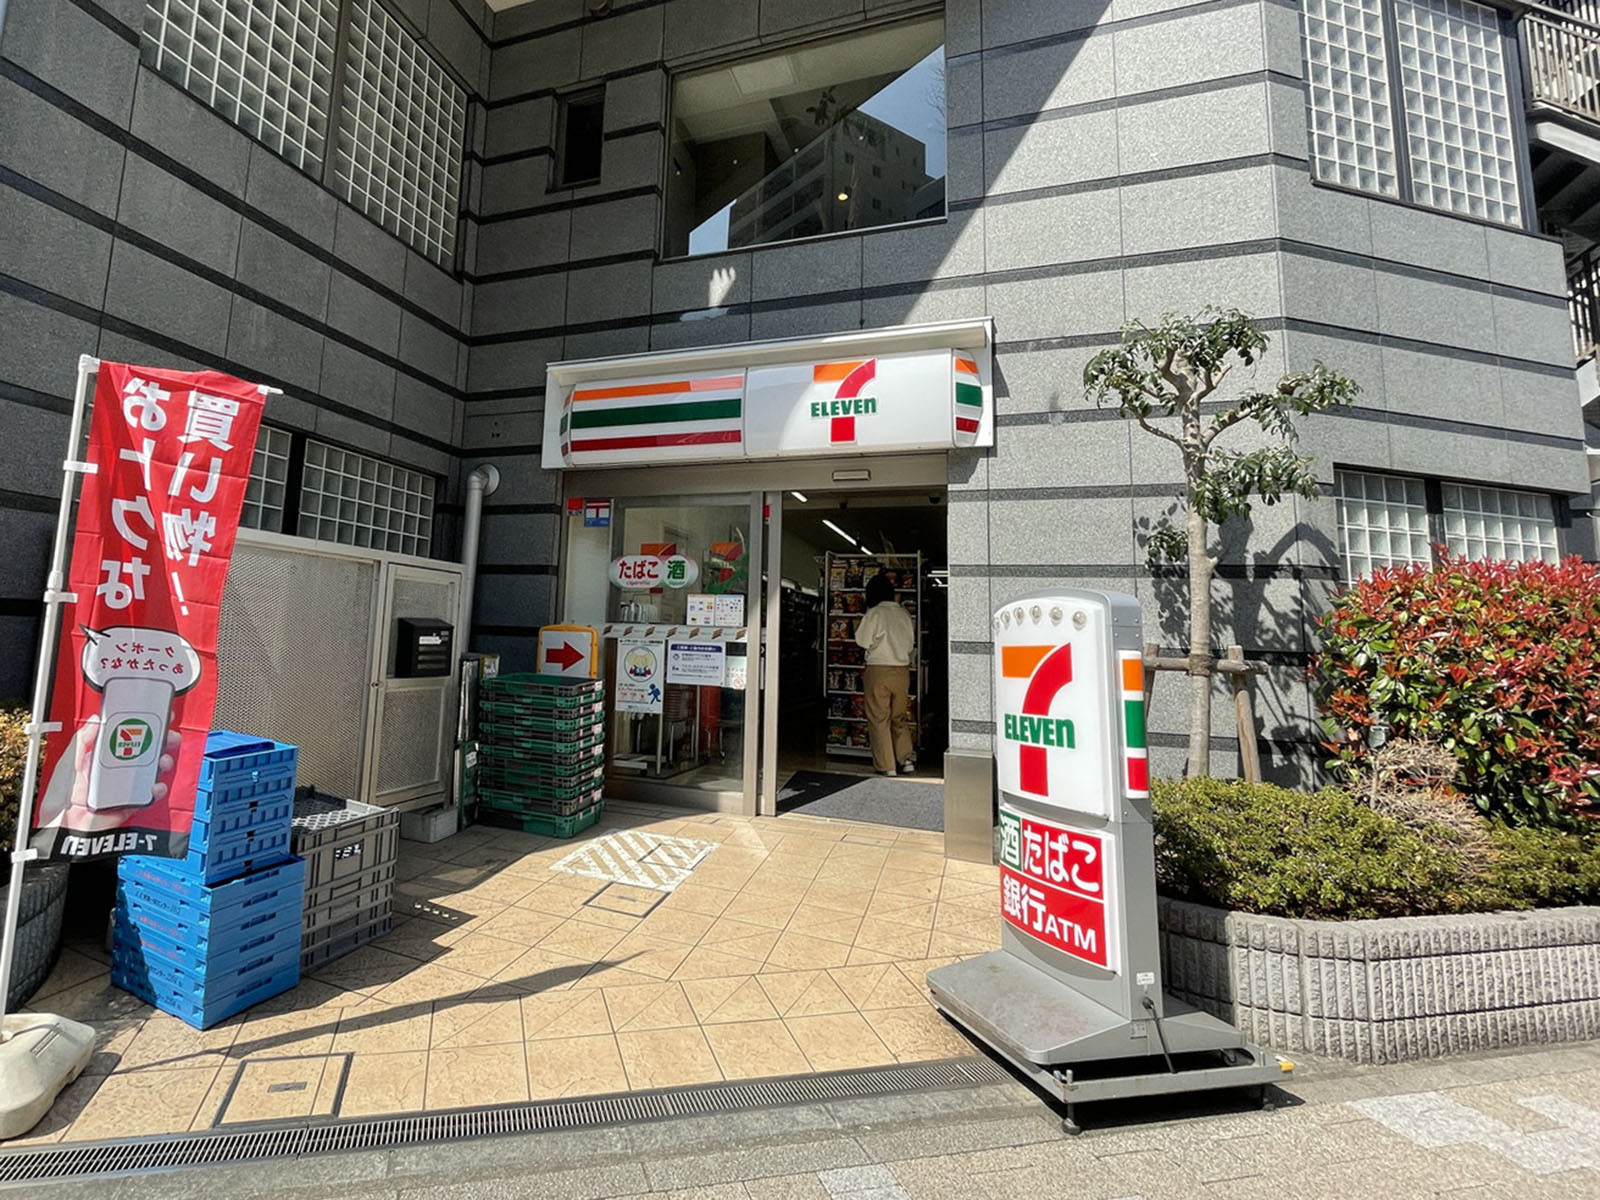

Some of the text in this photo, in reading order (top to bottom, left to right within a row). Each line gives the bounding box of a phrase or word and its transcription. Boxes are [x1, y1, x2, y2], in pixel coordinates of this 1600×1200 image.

[619, 560, 686, 580] たばこ 酒
[1001, 642, 1074, 797] 7
[999, 812, 1100, 893] 酒 たばこ
[1003, 874, 1097, 954] 銀行ATM
